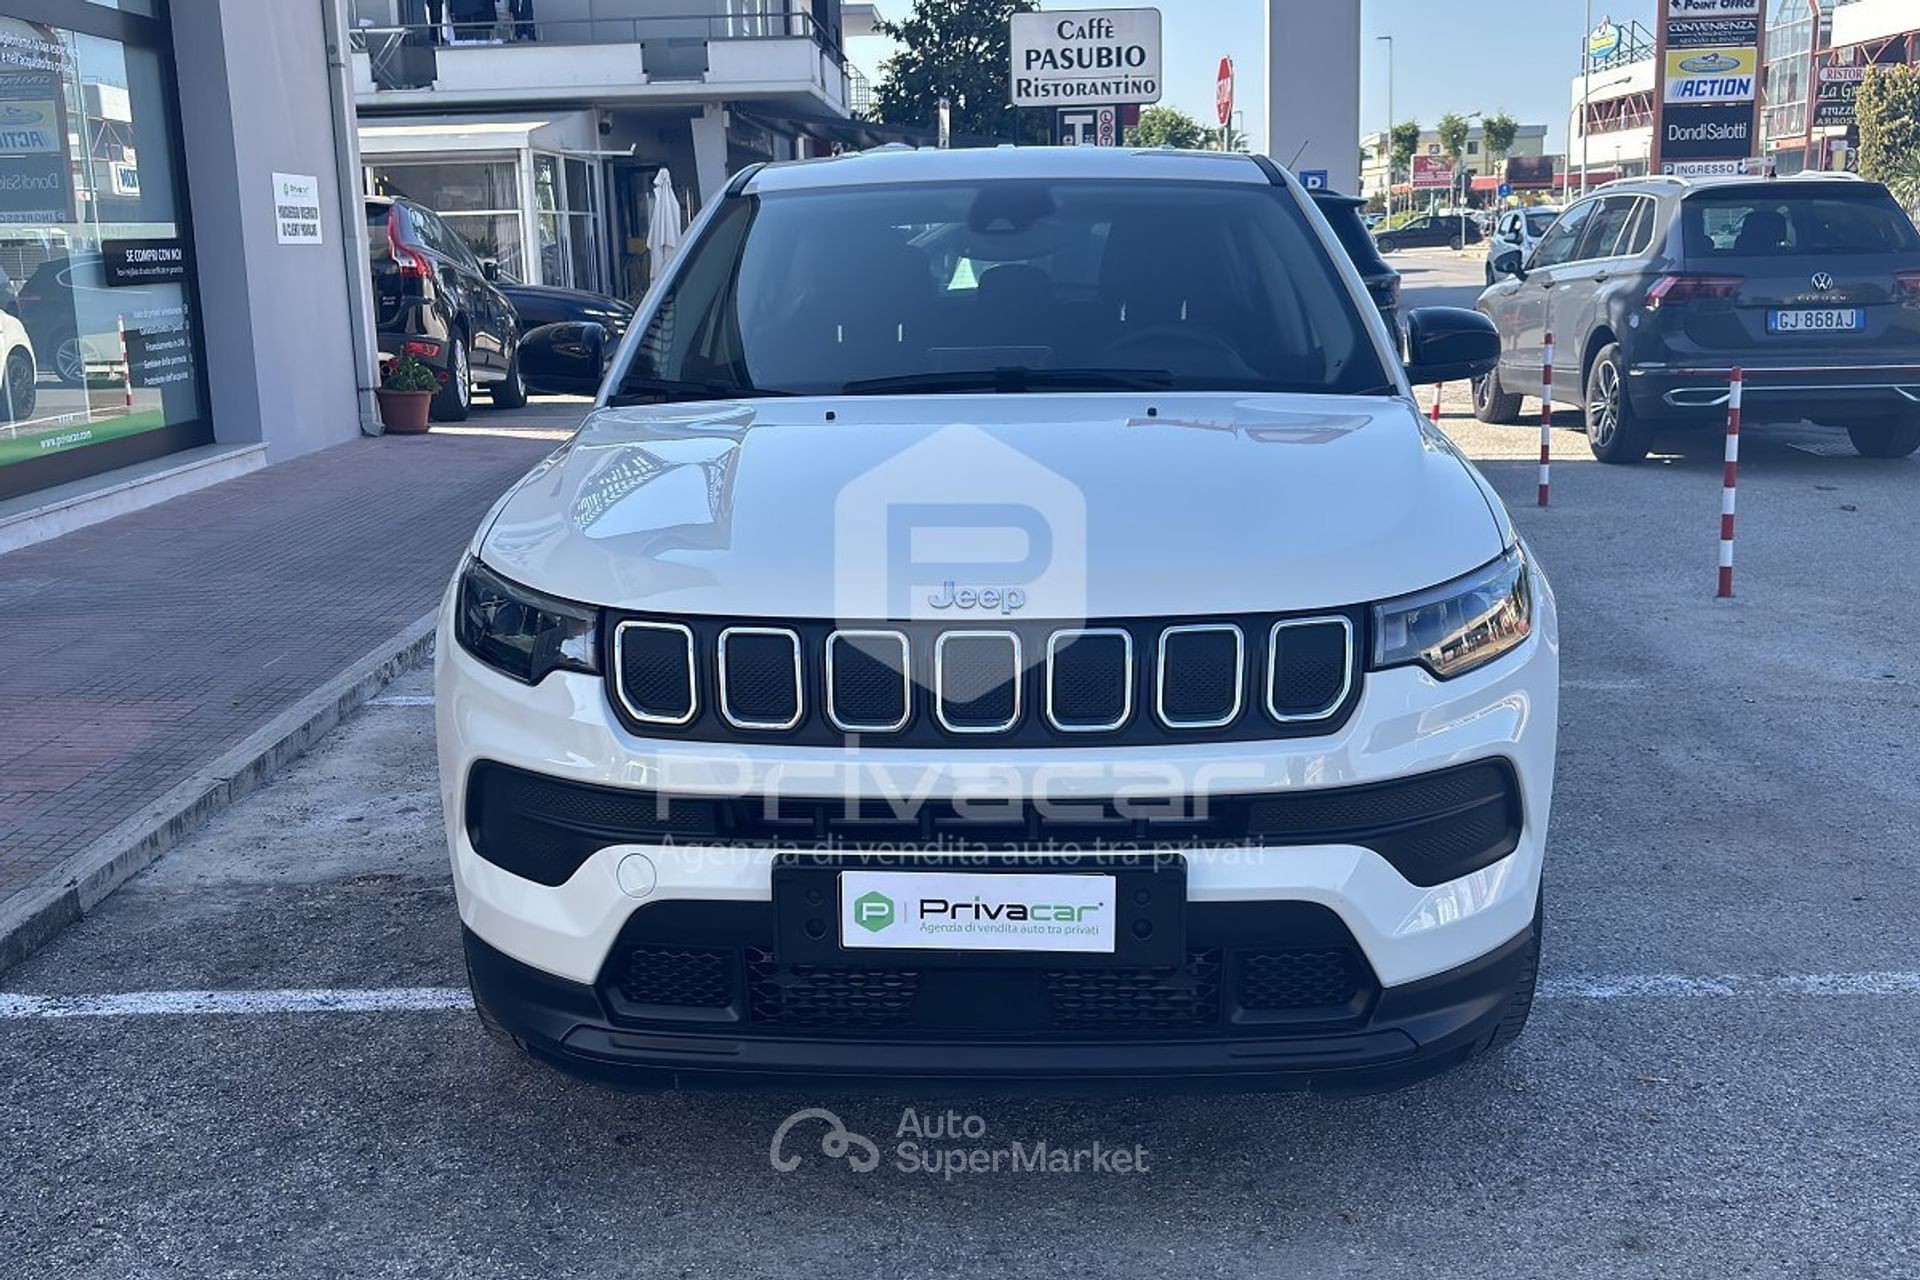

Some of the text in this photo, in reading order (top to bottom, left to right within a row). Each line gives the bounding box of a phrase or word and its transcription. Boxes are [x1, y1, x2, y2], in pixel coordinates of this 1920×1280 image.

[1057, 18, 1115, 40] Caffè
[1668, 21, 1756, 33] CONVENIENZA
[1025, 45, 1146, 71] PASUBIO
[1681, 78, 1751, 97] ACTION
[1819, 82, 1837, 98] La
[1821, 106, 1857, 116] STUZZI
[1668, 122, 1747, 141] DondiSalotti
[1677, 163, 1734, 175] INGRESSO
[928, 581, 1026, 615] Jeep
[920, 896, 1099, 922] Privacar
[920, 922, 1099, 936] Agenzia di vendita auto tra privati
